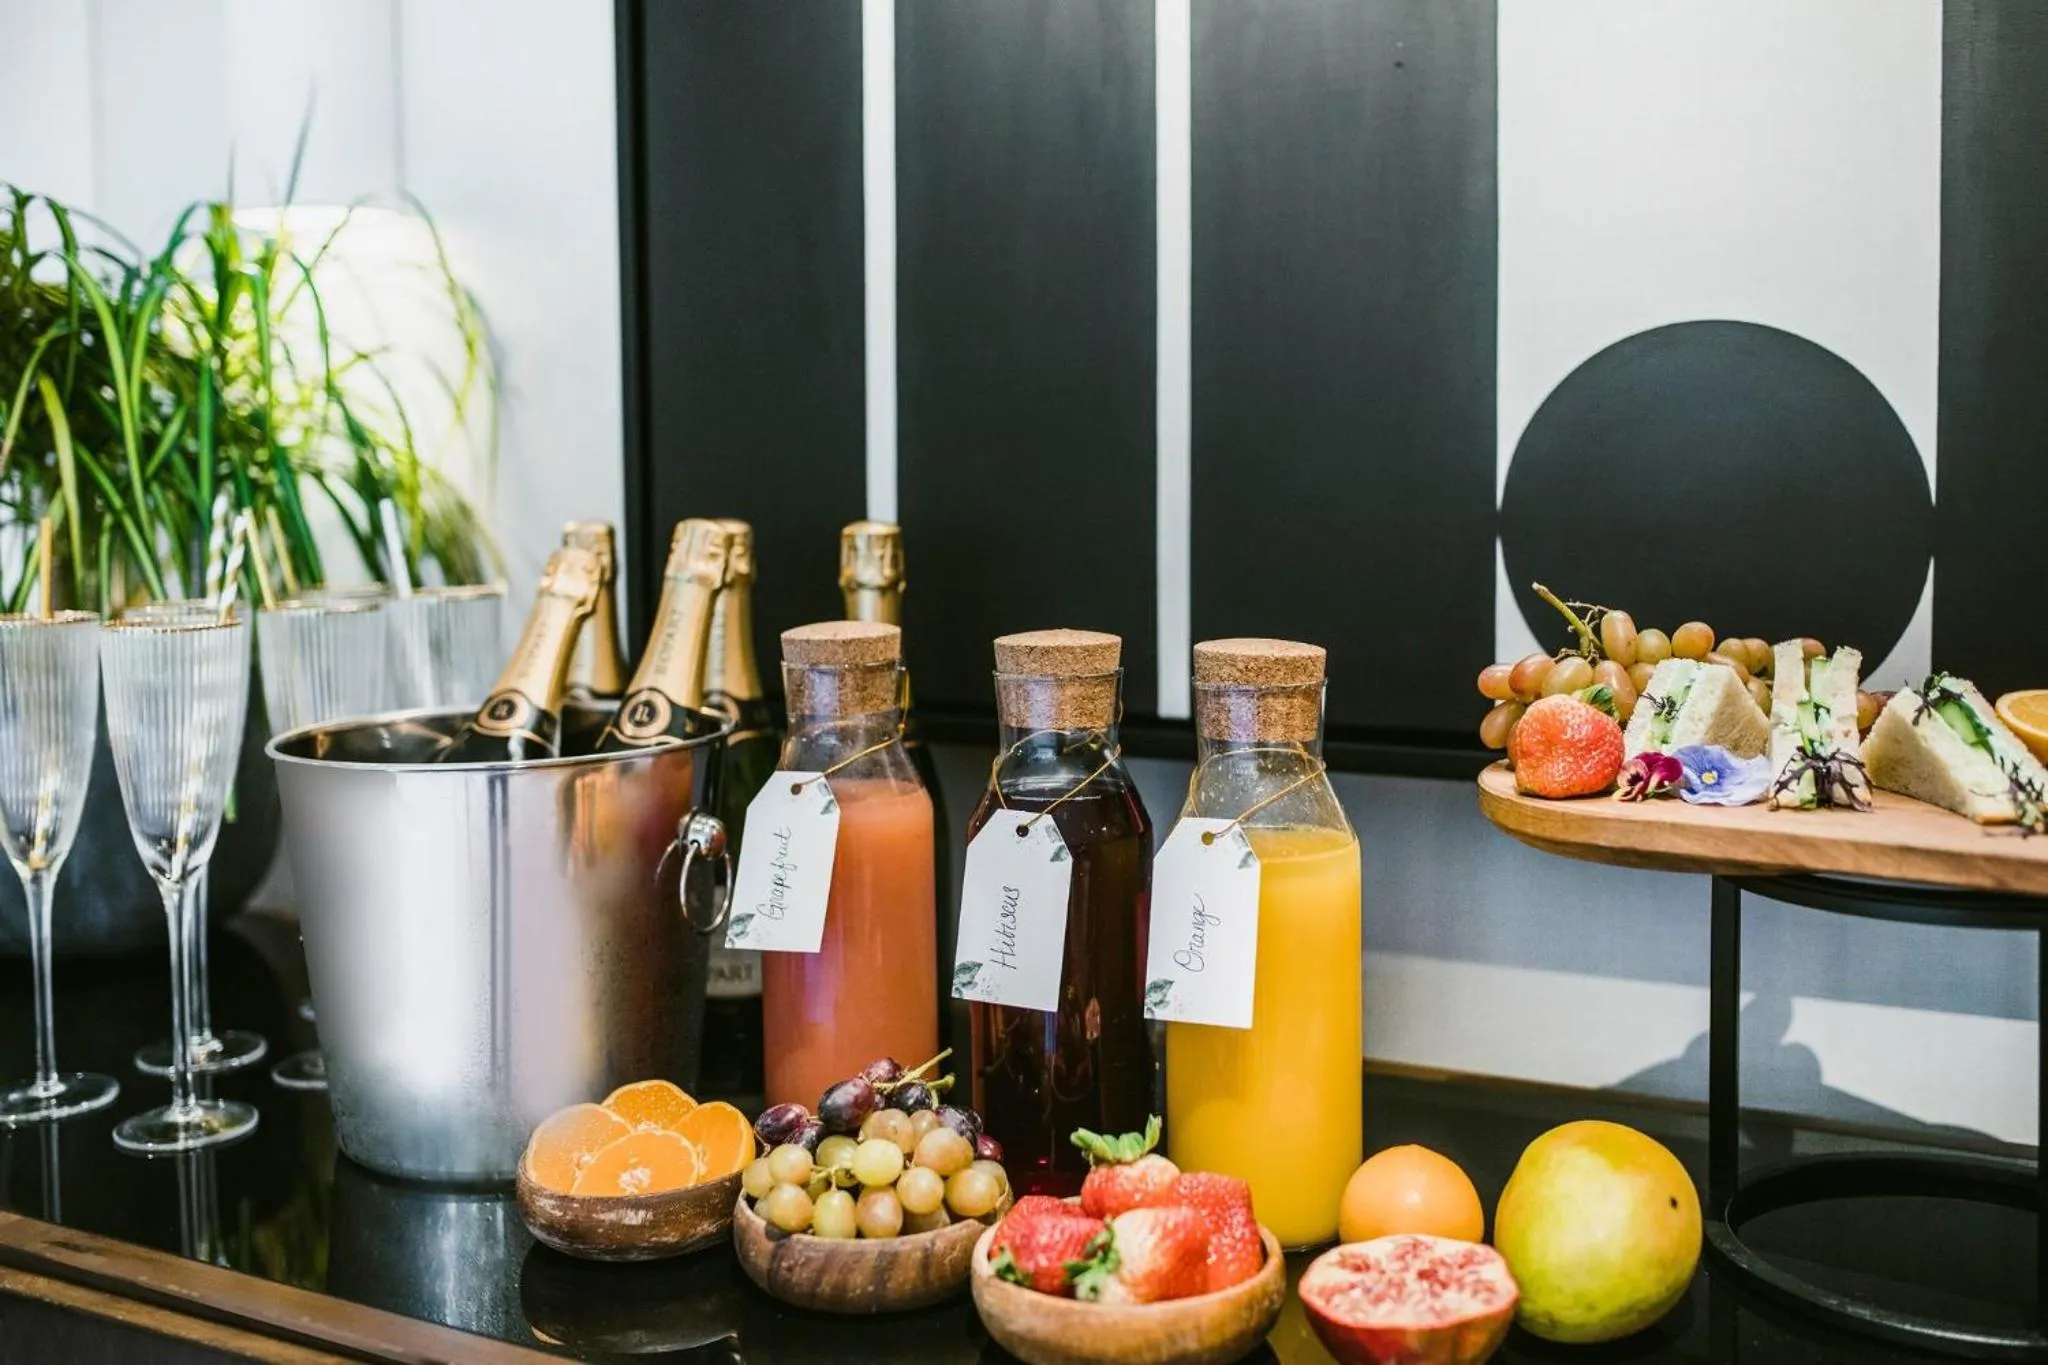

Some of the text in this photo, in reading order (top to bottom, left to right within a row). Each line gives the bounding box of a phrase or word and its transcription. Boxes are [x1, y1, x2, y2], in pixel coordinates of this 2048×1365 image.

[757, 826, 797, 920] Grapefruit
[990, 885, 1021, 970] Hibiscus
[1173, 893, 1222, 972] Orange
